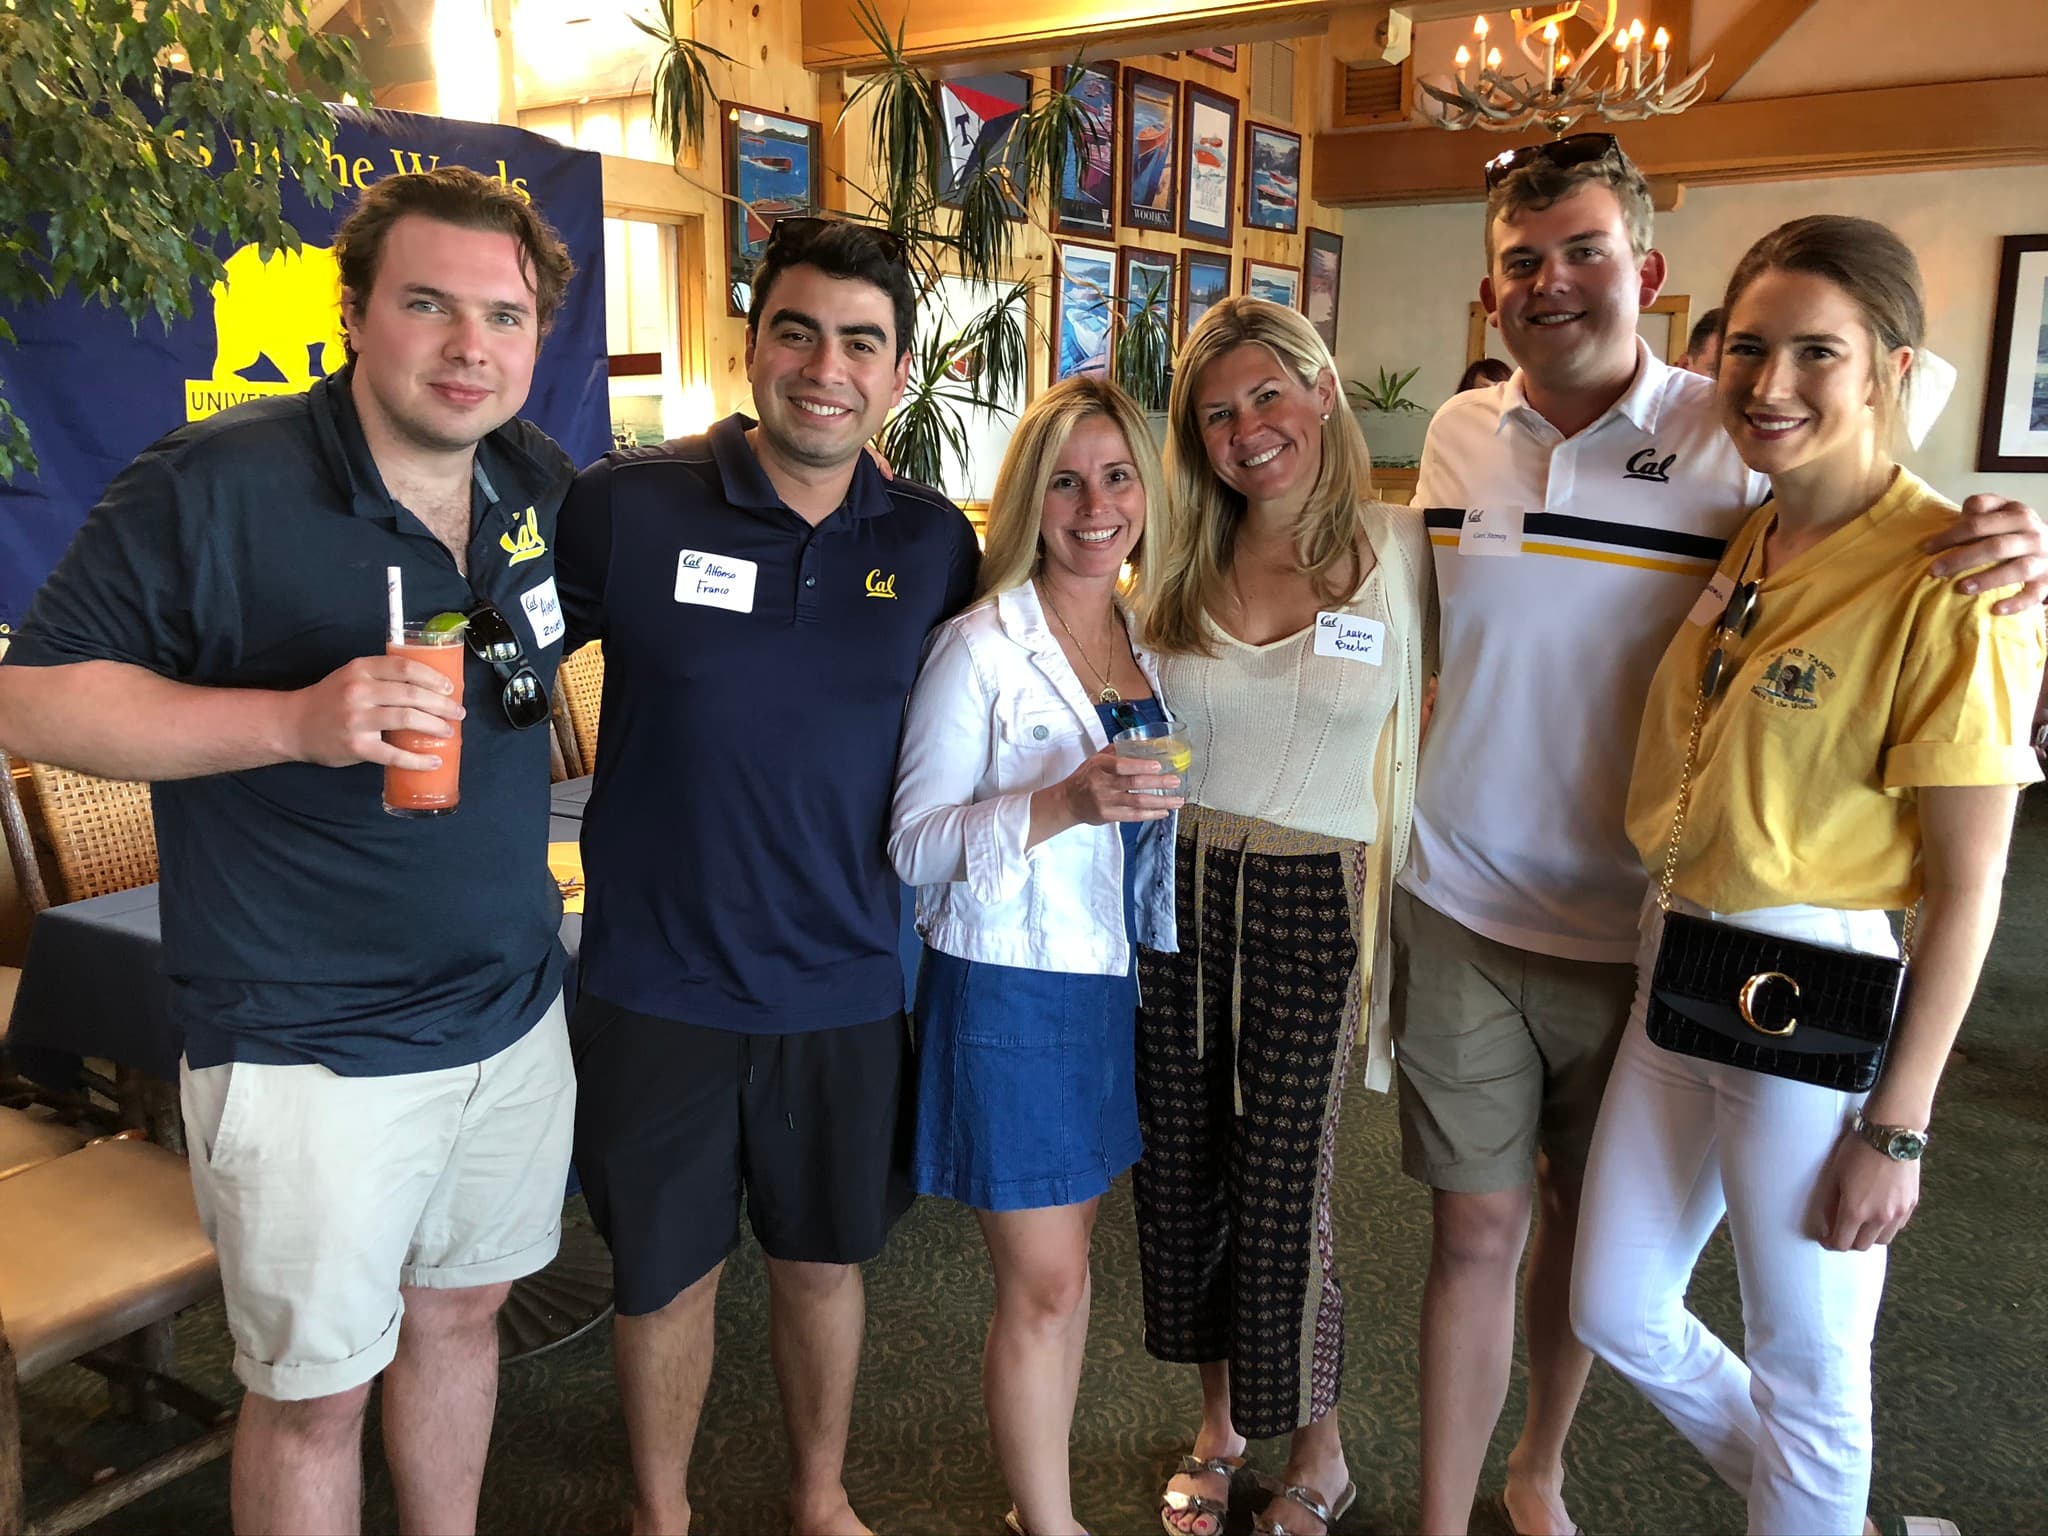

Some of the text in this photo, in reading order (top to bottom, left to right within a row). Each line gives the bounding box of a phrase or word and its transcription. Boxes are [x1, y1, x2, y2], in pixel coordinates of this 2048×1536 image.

[1622, 448, 1677, 483] Cal
[1466, 509, 1485, 523] Cal
[682, 554, 703, 569] Cal
[704, 563, 737, 579] Alfonso
[696, 579, 730, 595] Franco
[866, 569, 898, 600] Cal
[525, 593, 539, 613] Cal
[1320, 615, 1338, 628] Cal
[1338, 623, 1374, 643] Lauren
[1738, 971, 1800, 1037] C
